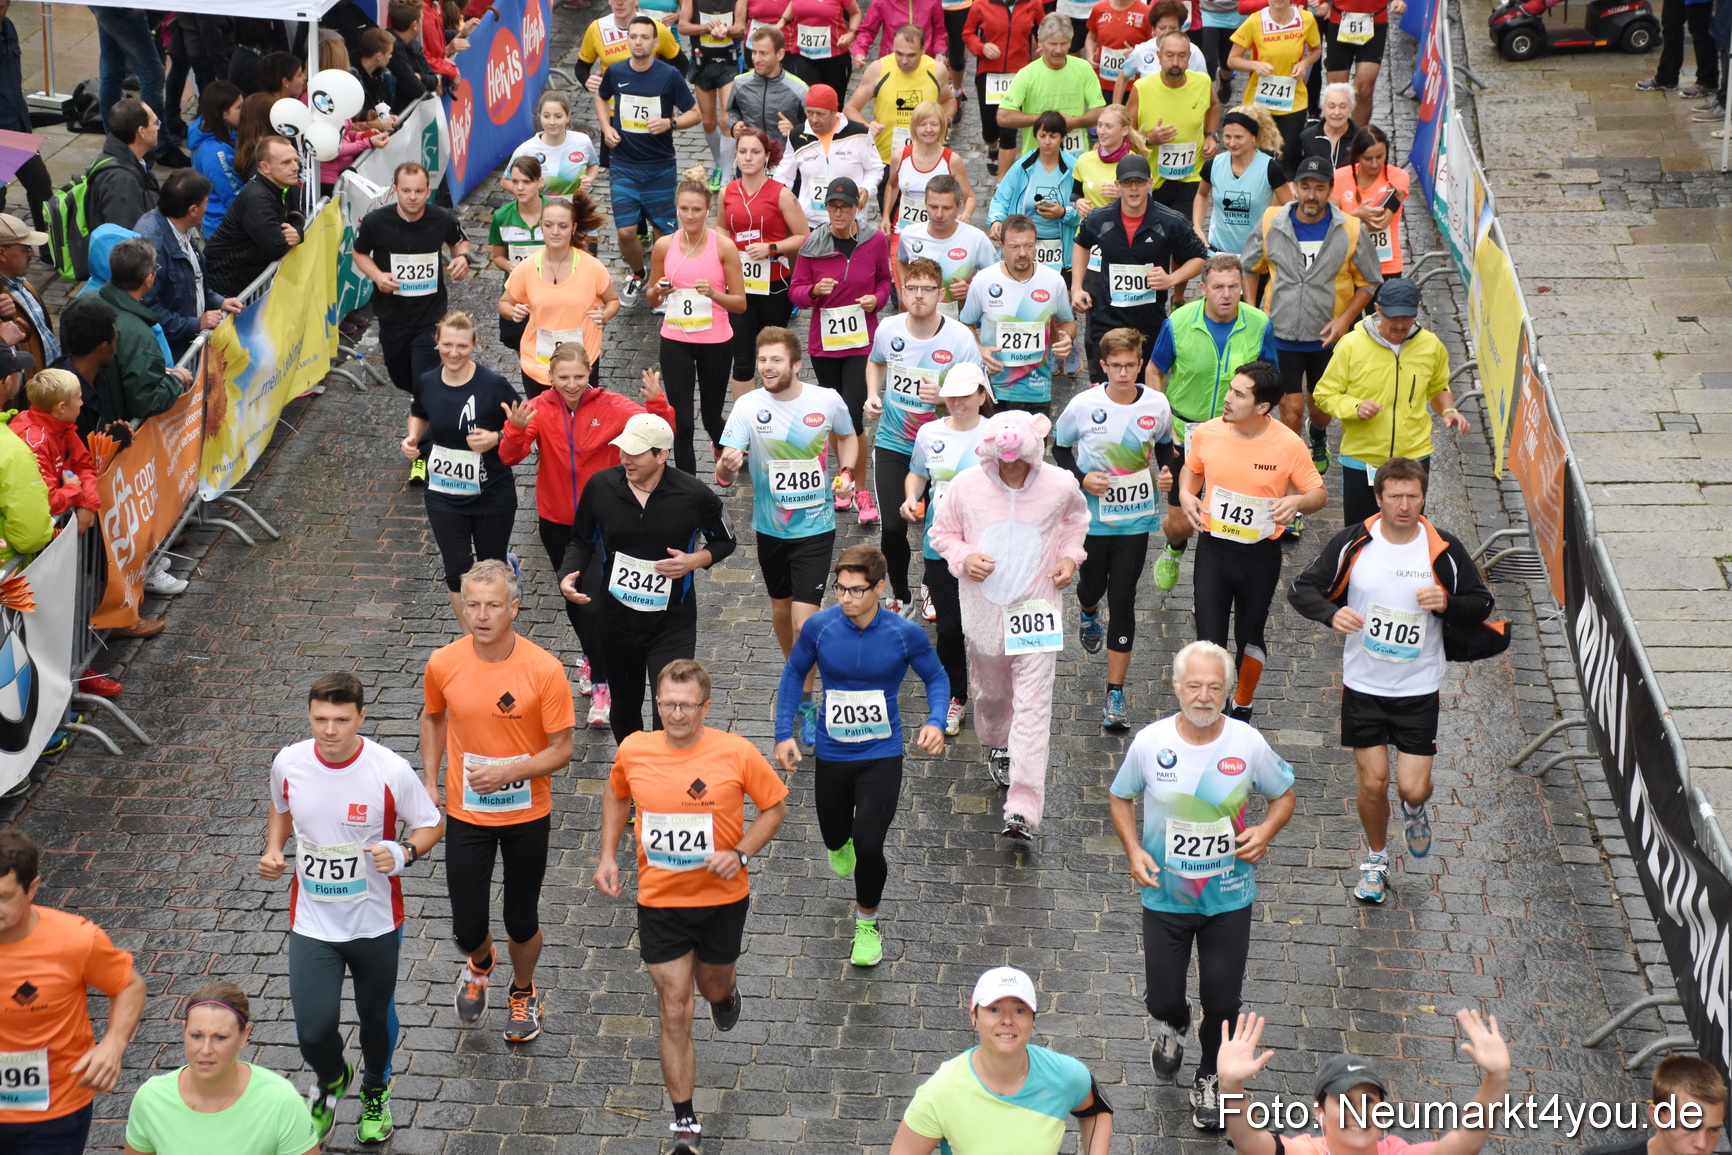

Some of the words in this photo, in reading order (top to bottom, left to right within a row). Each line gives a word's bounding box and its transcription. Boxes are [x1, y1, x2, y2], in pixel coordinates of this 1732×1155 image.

[1349, 20, 1363, 33] 61
[800, 33, 828, 48] 2877
[1263, 34, 1282, 43] MAX
[605, 44, 628, 56] MAX
[1103, 55, 1124, 70] 208
[487, 45, 523, 109] Hervis
[1260, 81, 1291, 99] 2741
[632, 105, 649, 120] 75
[450, 97, 472, 167] Hervis
[1162, 150, 1194, 166] 2717
[1168, 166, 1188, 176] Josef
[903, 206, 928, 221] 276
[1035, 248, 1062, 263] 903
[396, 263, 435, 281] 2325
[743, 261, 762, 279] 30
[402, 282, 430, 291] Christian
[683, 299, 692, 316] 8
[828, 315, 858, 334] 210
[1002, 332, 1039, 350] 2871
[893, 374, 922, 395] 221
[900, 397, 923, 408] Markus
[433, 458, 475, 481] 2240
[440, 479, 467, 490] Daniela
[775, 469, 821, 491] 2486
[780, 493, 817, 503] Alexander
[1104, 482, 1149, 503] 3079
[1220, 502, 1254, 526] 143
[1221, 525, 1240, 535] Sven
[616, 566, 667, 594] 2342
[622, 592, 655, 606] Andreas
[1010, 612, 1055, 635] 3081
[1369, 617, 1421, 645] 3105
[832, 704, 882, 725] 2033
[844, 726, 874, 737] Patrick
[1221, 760, 1244, 773] Hervis
[1156, 771, 1178, 779] PARTL
[478, 794, 515, 805] Michael
[649, 829, 708, 852] 2124
[1173, 833, 1231, 858] 2275
[303, 853, 359, 881] 2757
[1180, 859, 1222, 872] Raimund
[315, 884, 348, 895] Florian
[0, 1065, 41, 1089] 96
